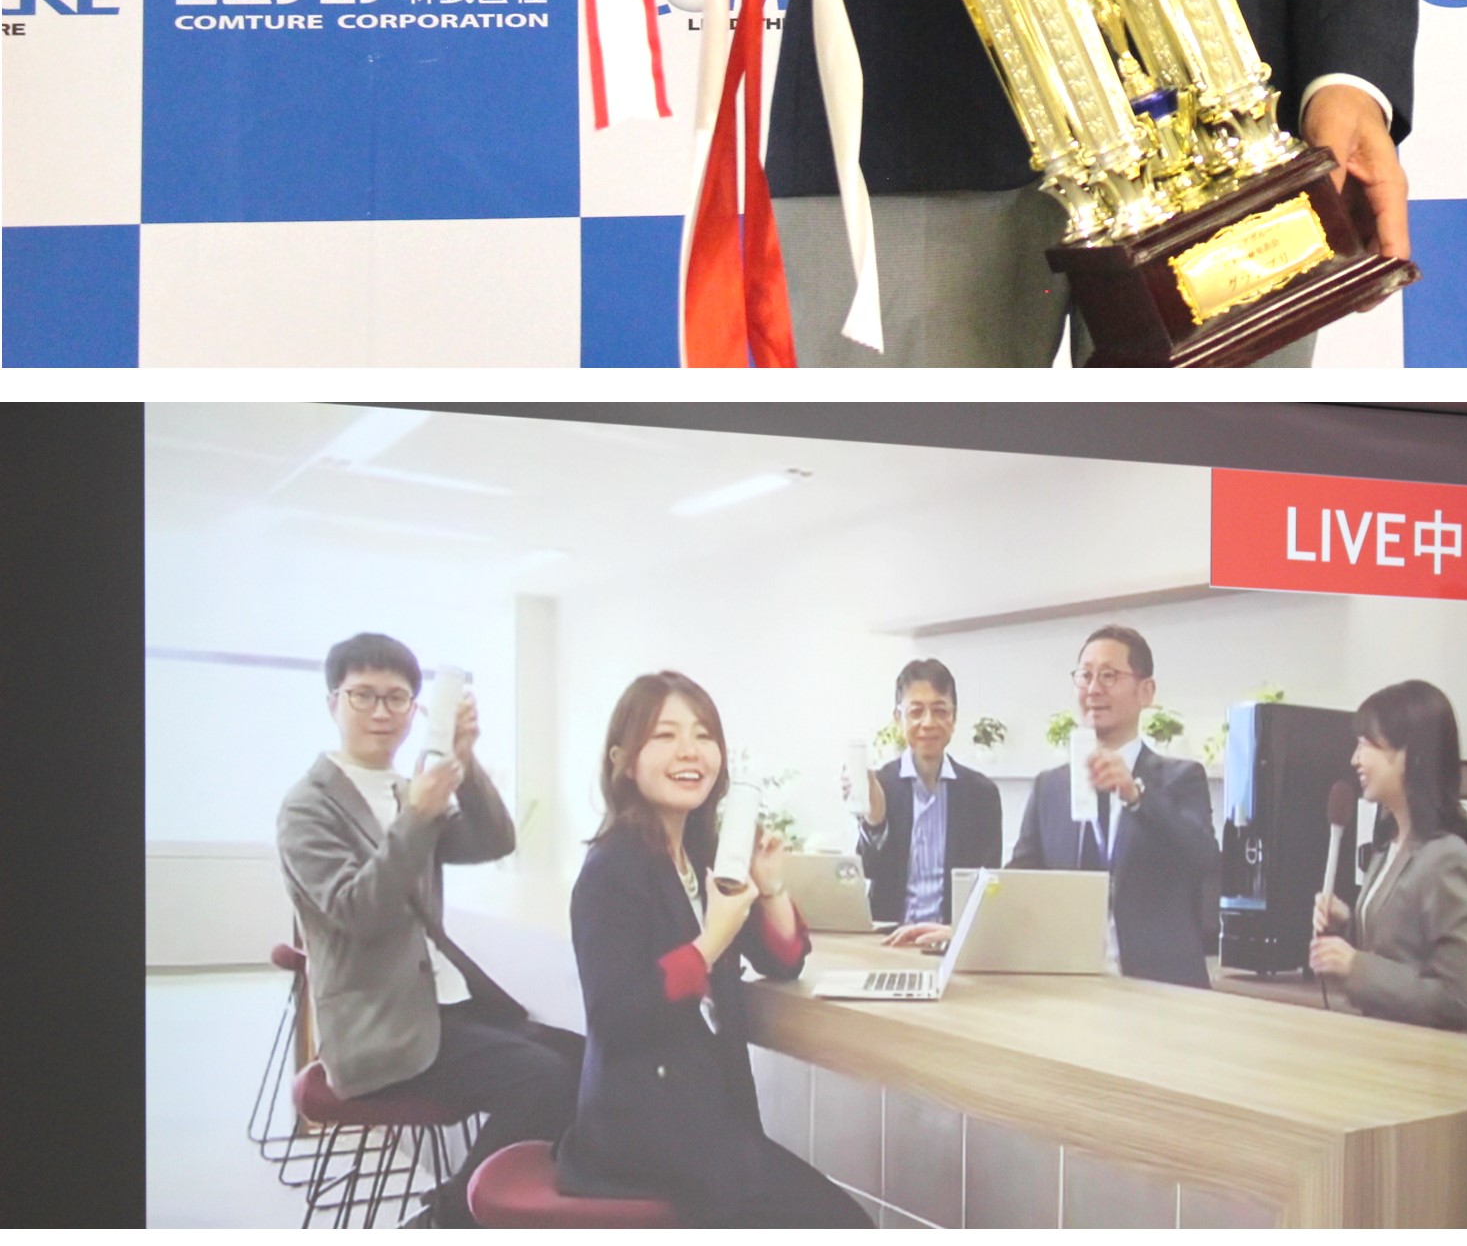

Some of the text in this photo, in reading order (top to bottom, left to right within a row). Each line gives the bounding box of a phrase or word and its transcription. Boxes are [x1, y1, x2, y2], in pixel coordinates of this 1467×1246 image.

[175, 14, 548, 30] COMTURE CORPORATION
[1286, 506, 1463, 575] LIVE中
